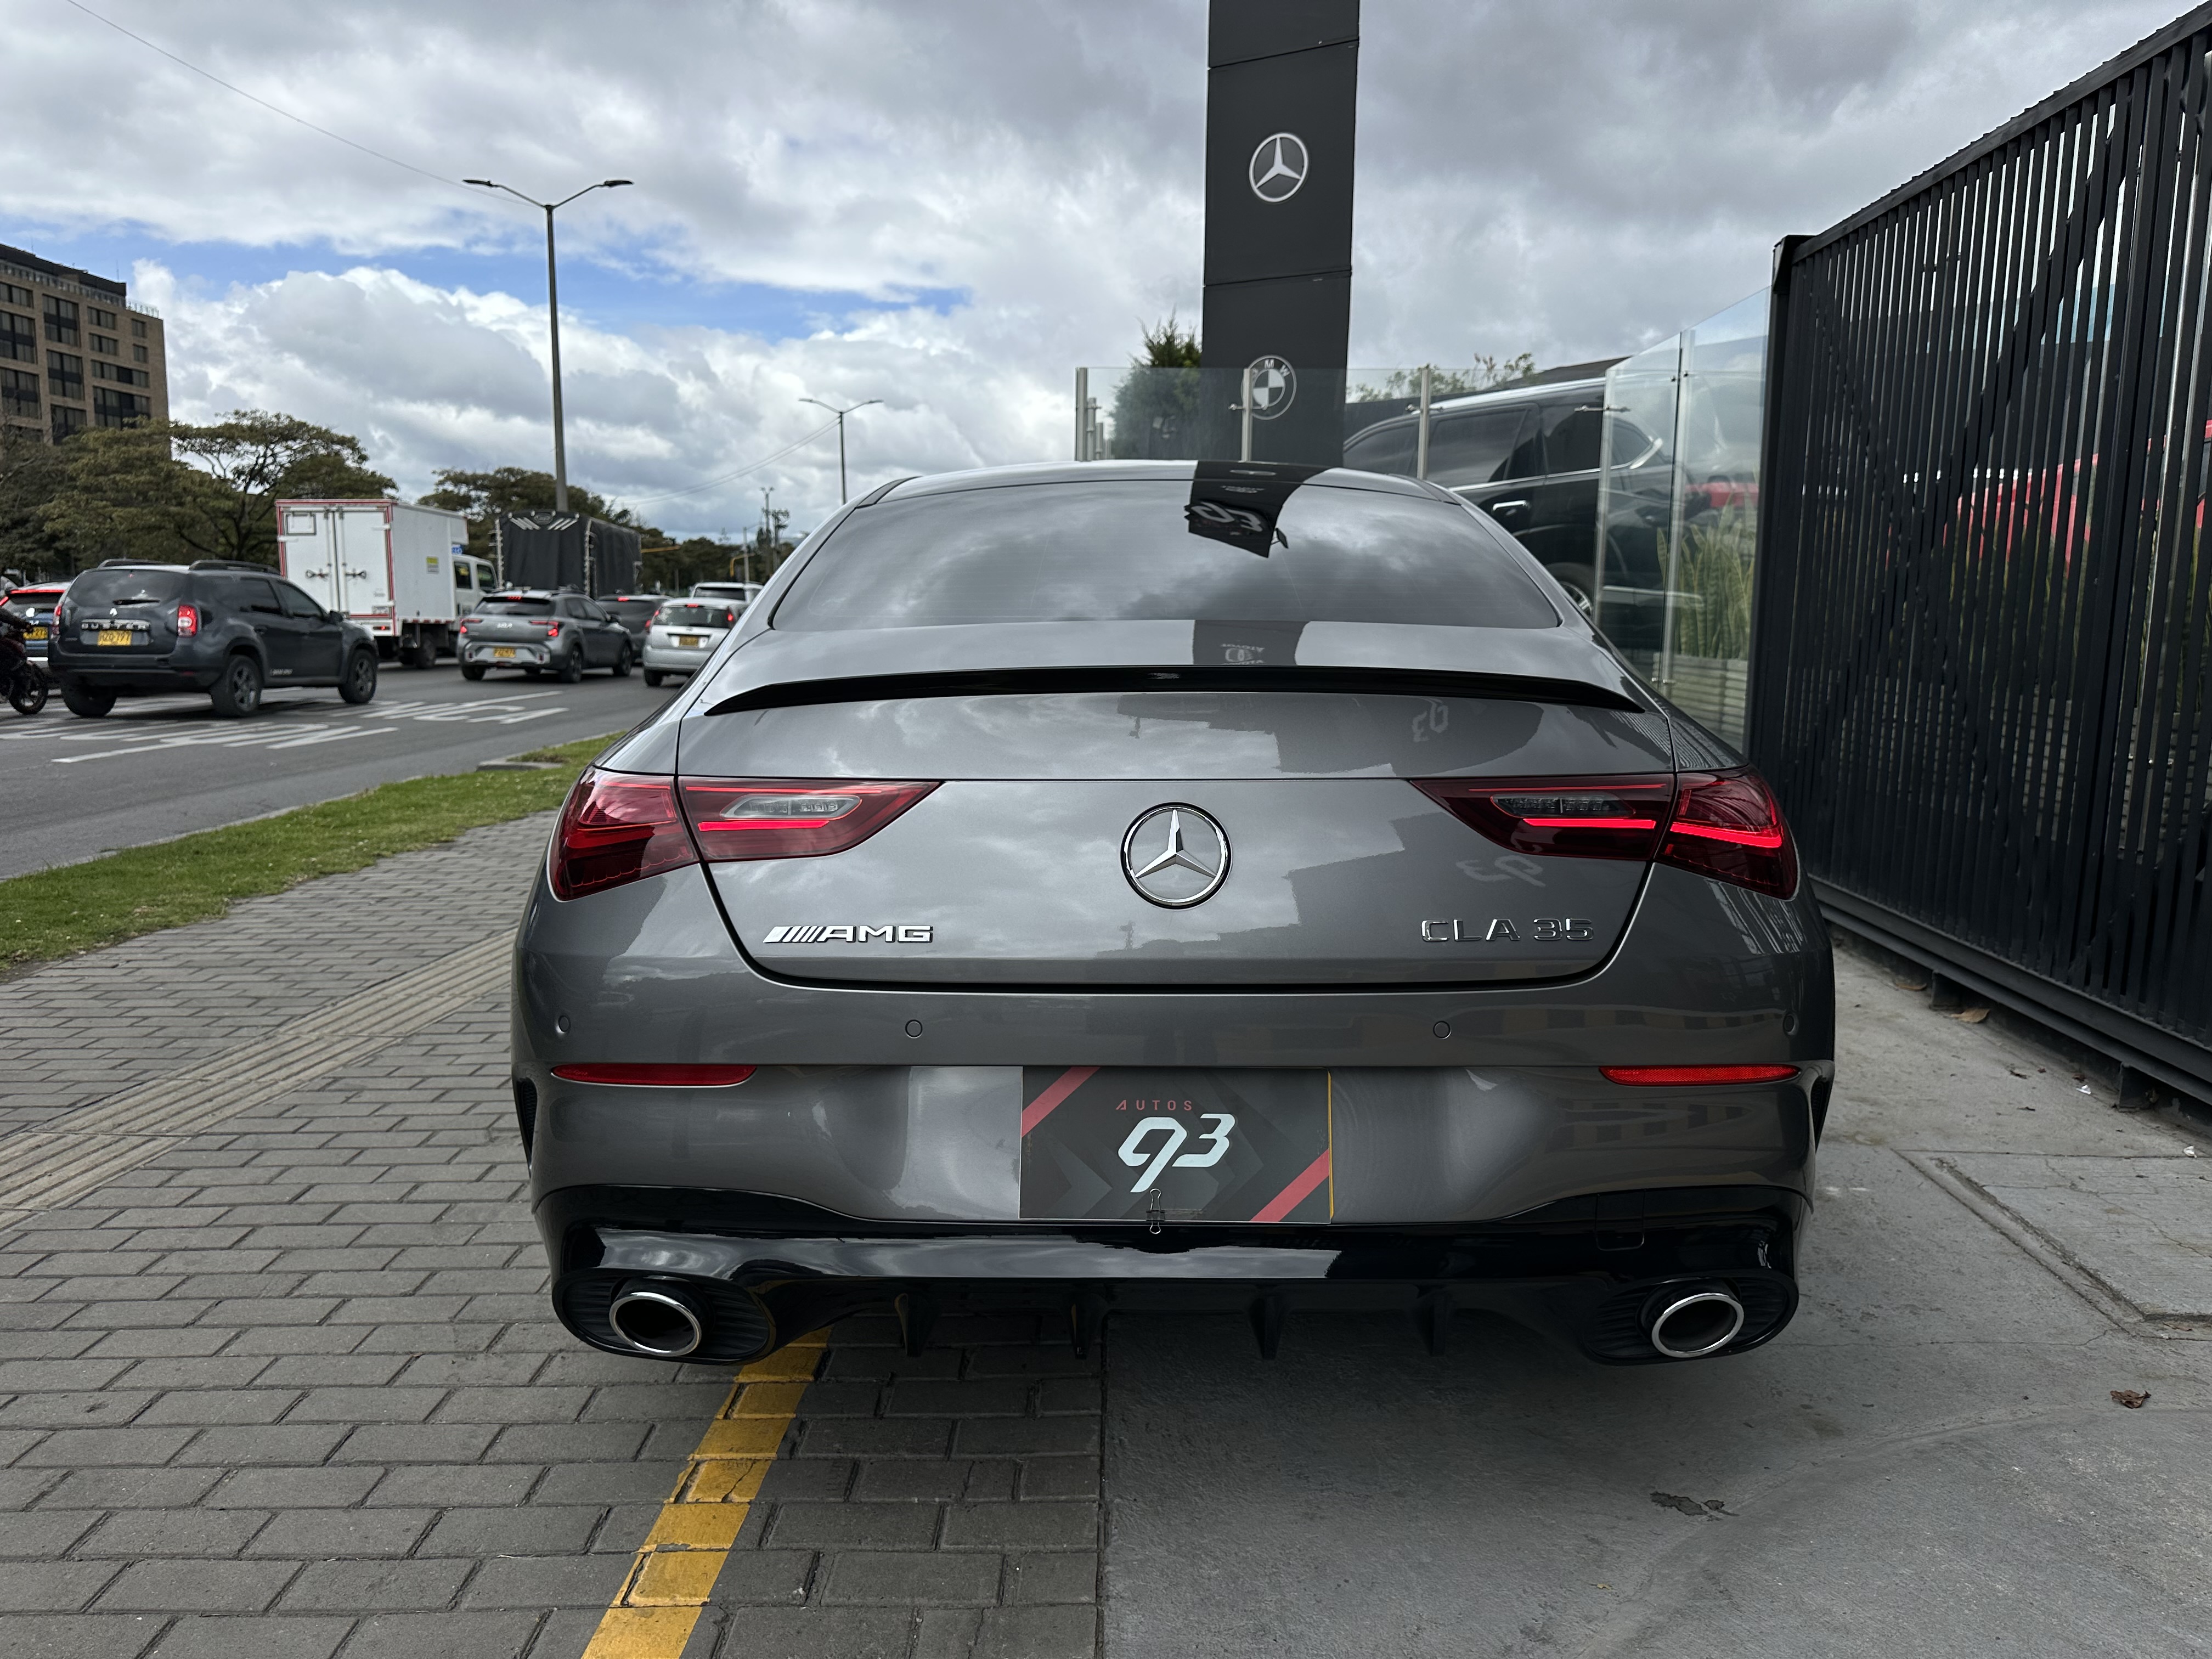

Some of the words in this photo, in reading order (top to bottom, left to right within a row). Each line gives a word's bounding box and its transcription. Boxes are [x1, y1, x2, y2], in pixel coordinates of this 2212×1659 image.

[816, 926, 933, 943] AMG
[1421, 918, 1521, 942] CLA
[1533, 917, 1594, 941] 35
[1115, 1100, 1193, 1111] AUTOS
[1118, 1113, 1236, 1193] 93
